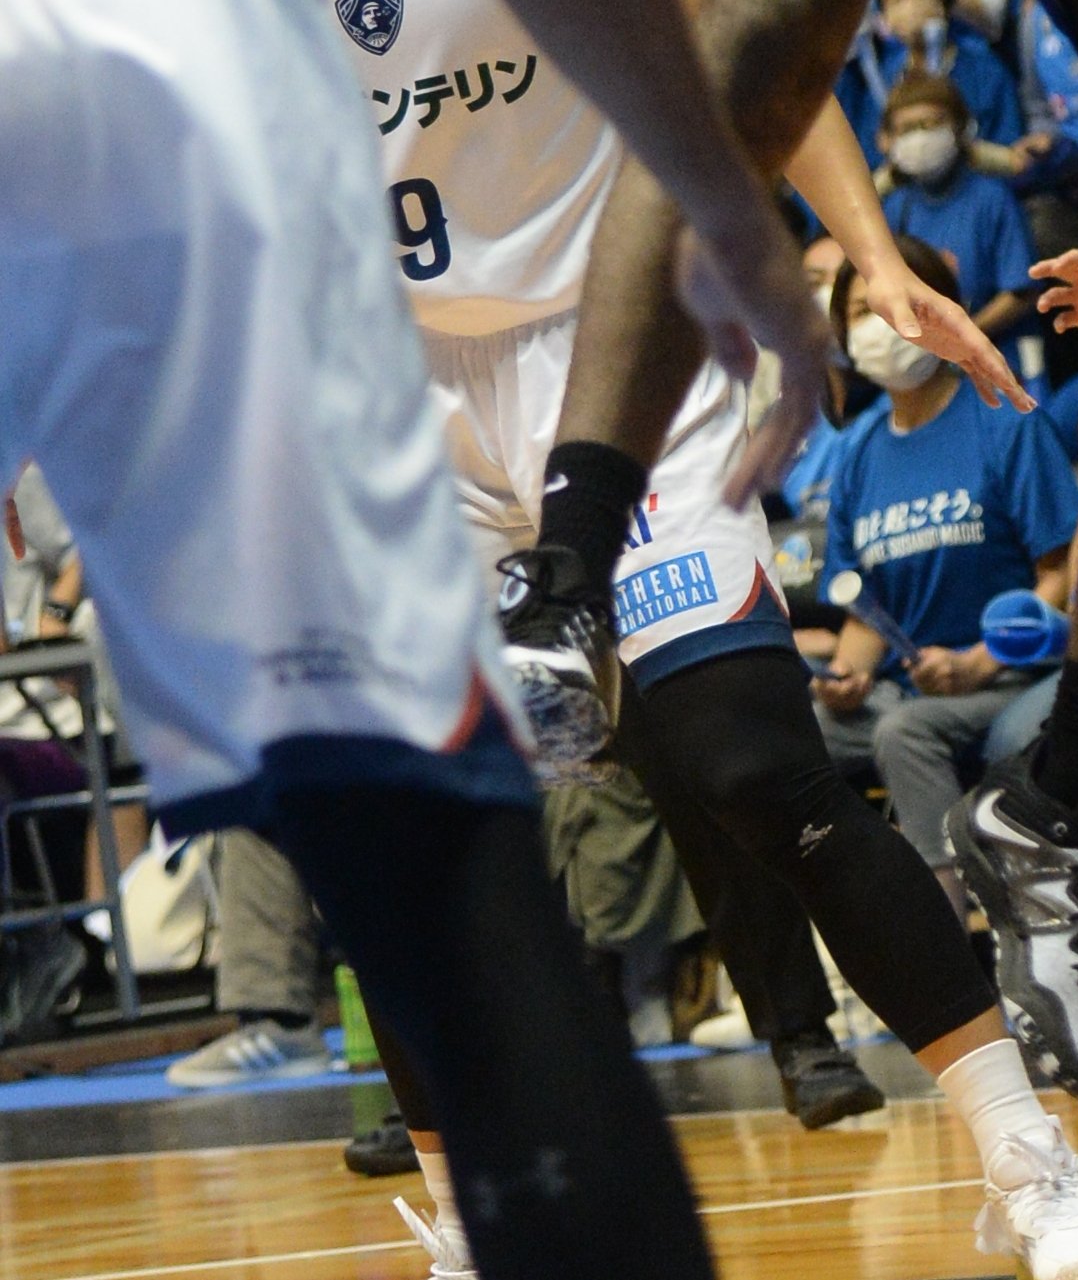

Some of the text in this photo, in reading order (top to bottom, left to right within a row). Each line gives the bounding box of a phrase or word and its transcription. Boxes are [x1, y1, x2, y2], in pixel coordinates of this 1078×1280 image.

[371, 54, 537, 136] ンテリン
[387, 177, 452, 281] 9
[614, 556, 706, 617] THERN
